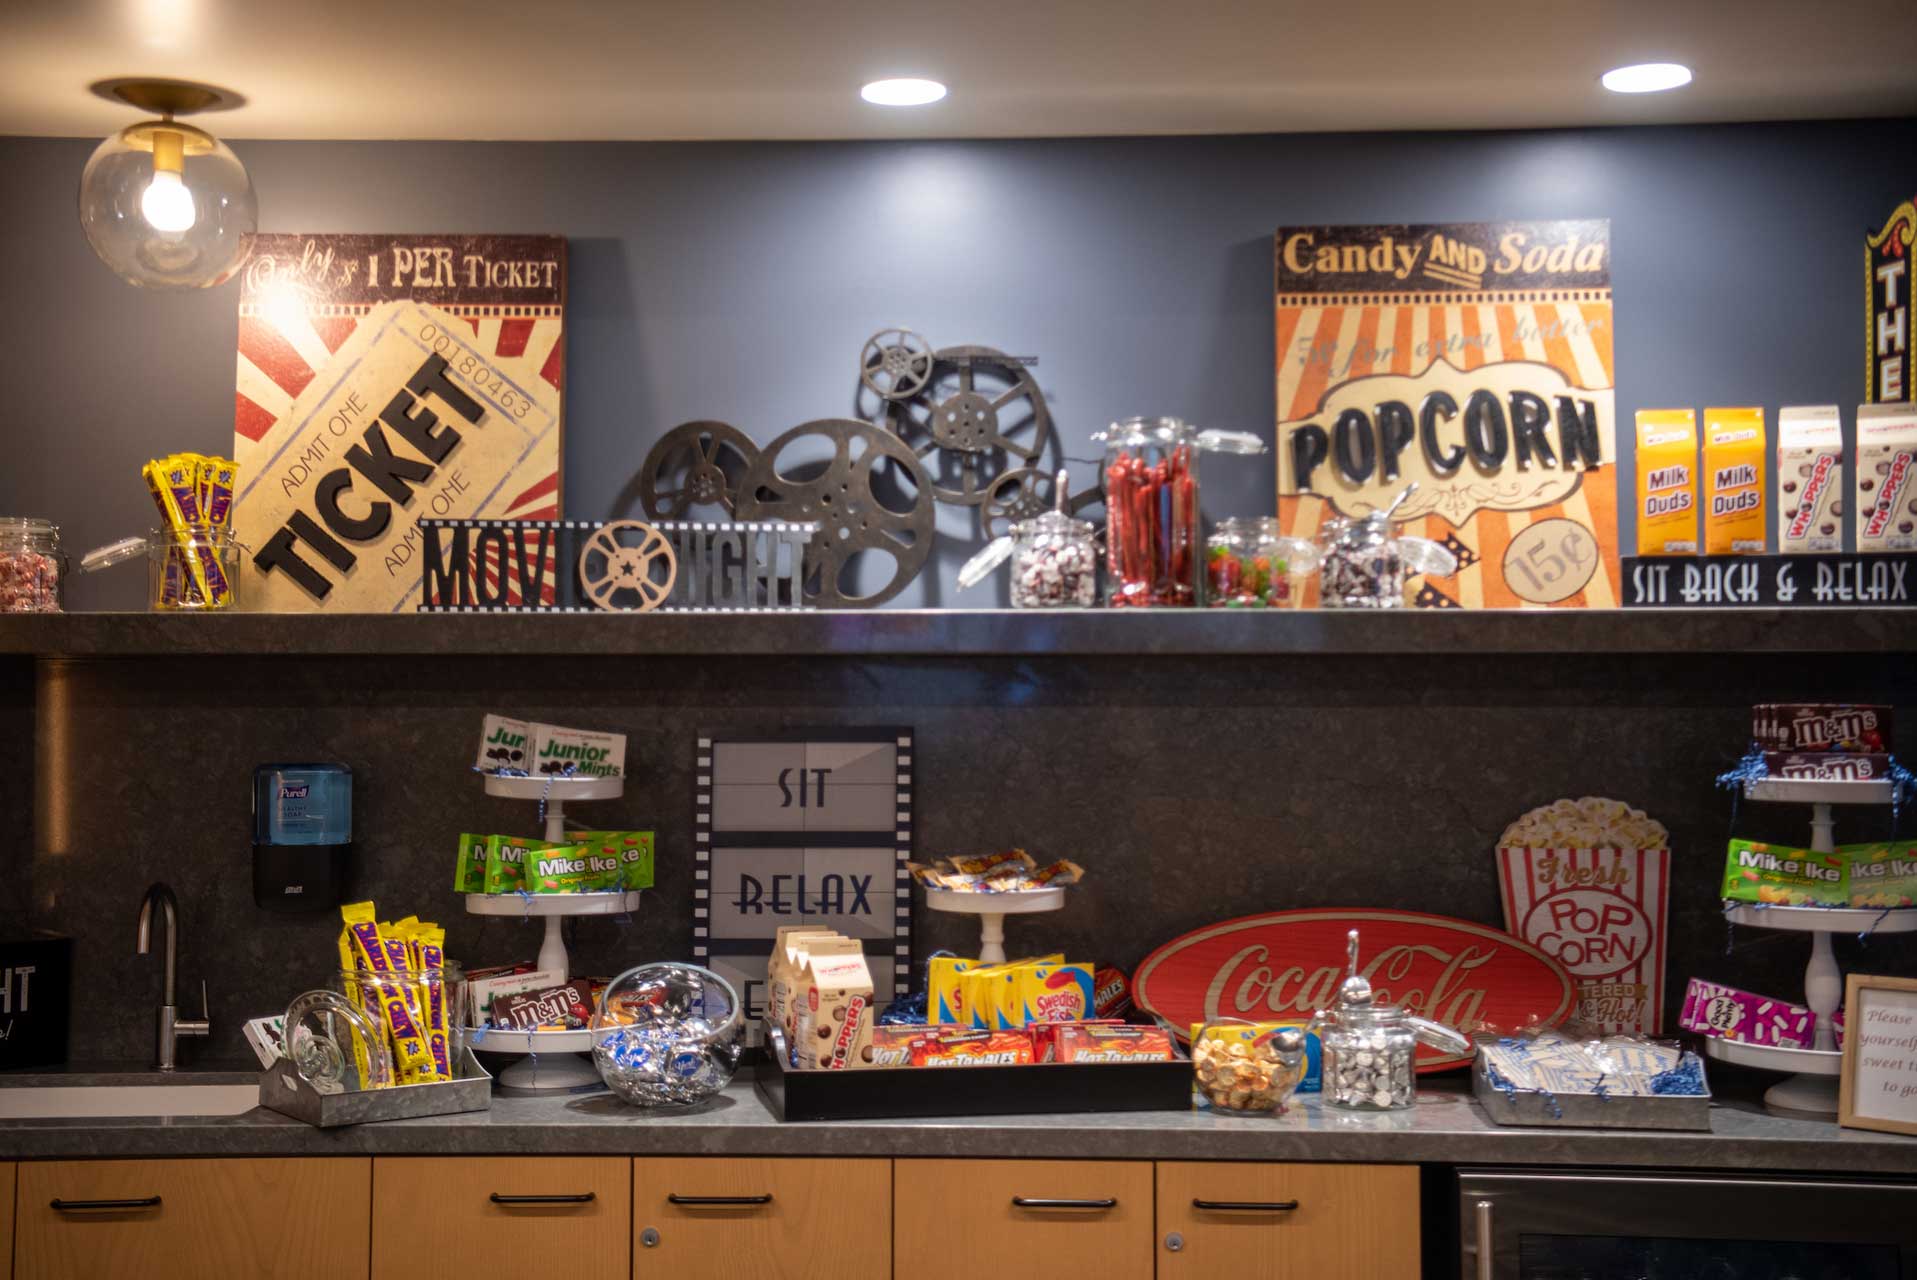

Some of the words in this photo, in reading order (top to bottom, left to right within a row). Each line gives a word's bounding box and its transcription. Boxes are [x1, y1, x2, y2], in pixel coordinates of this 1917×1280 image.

[393, 247, 456, 288] PER
[1284, 234, 1421, 278] Candy
[1430, 234, 1487, 274] AND
[1494, 232, 1604, 273] Soda
[1415, 329, 1493, 357] extra
[1512, 315, 1604, 342] butter
[1877, 260, 1905, 401] THE
[281, 436, 332, 497] ADMIT
[329, 391, 368, 437] ONE
[1289, 388, 1602, 493] POPCORN
[253, 352, 486, 600] TICKET
[1649, 467, 1686, 490] Milk
[1717, 466, 1754, 489] Milk
[1789, 455, 1833, 537] WHOPPERS
[1866, 453, 1911, 537] WHOPPERS
[1647, 492, 1690, 515] Duds
[1714, 491, 1758, 515] Duds
[384, 510, 426, 578] ADM
[431, 470, 472, 515] ONE
[423, 528, 551, 606] MOV
[1509, 526, 1592, 592] 15¢
[1633, 565, 1669, 603] SIT
[1680, 563, 1759, 602] BACK
[1776, 563, 1797, 602] &
[1812, 562, 1908, 601] RELAX
[539, 739, 611, 761] Junior
[579, 761, 622, 778] Mints
[778, 768, 832, 808] SIT
[539, 858, 585, 877] Mike
[590, 856, 617, 873] Ike
[1537, 856, 1632, 884] Fresh
[1739, 850, 1799, 874] Mike
[1805, 862, 1841, 882] Ike
[732, 873, 872, 915] RELAX
[1548, 898, 1634, 935] POP
[1536, 932, 1636, 966] CORN
[1037, 991, 1081, 1017] Swedish
[1868, 1009, 1913, 1025] Please
[831, 997, 864, 1070] HOPPERS
[1883, 1080, 1898, 1093] to
